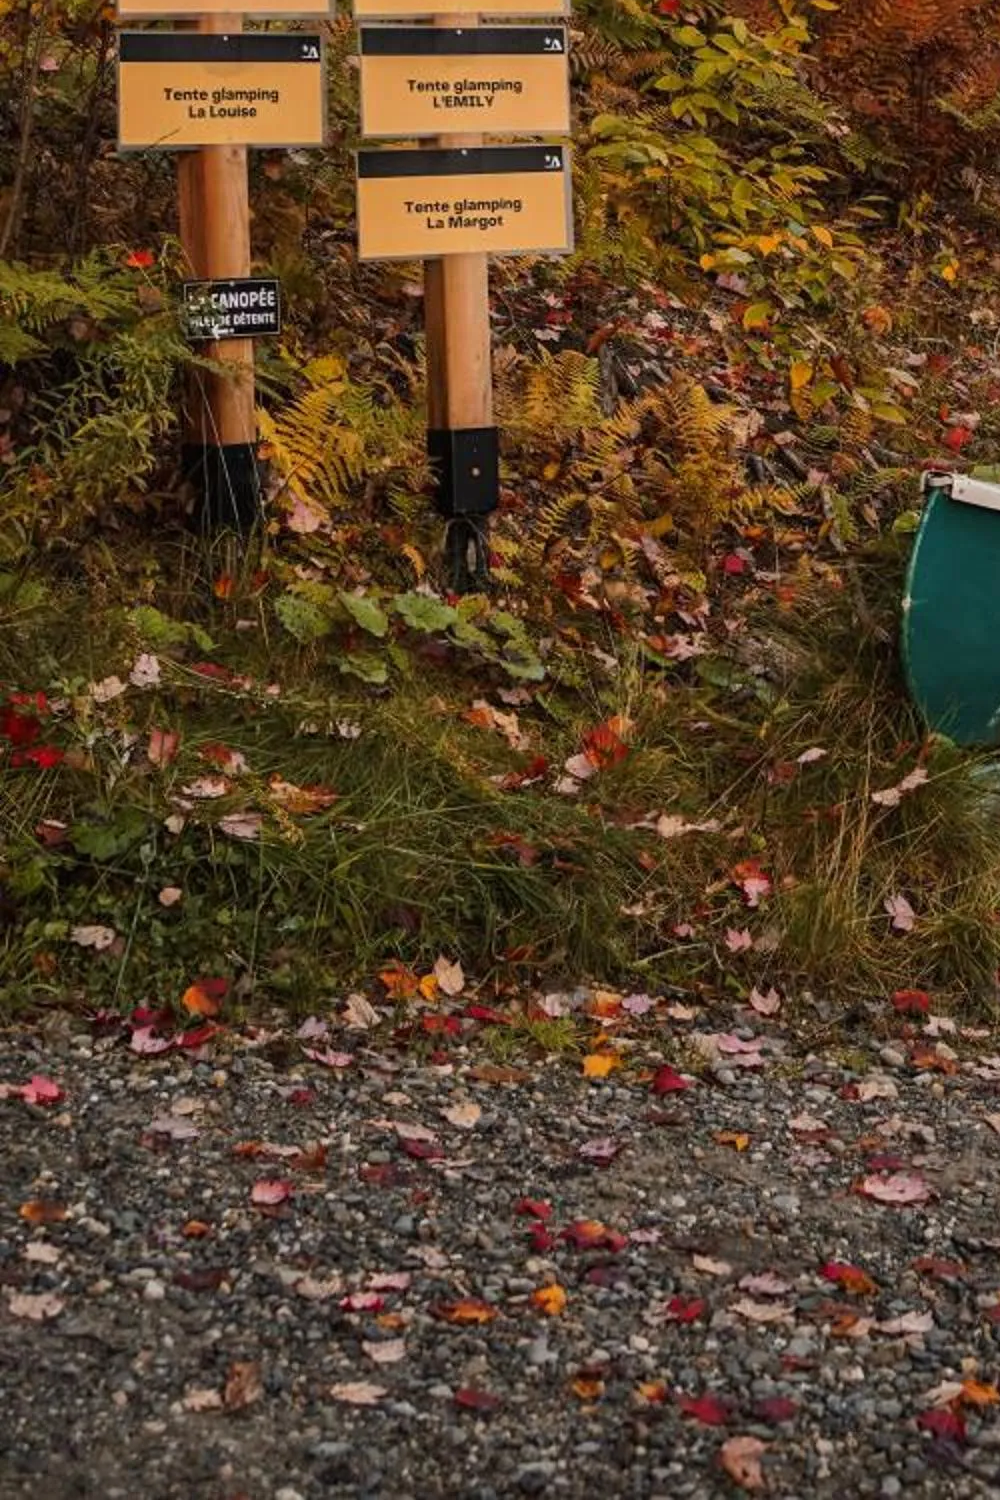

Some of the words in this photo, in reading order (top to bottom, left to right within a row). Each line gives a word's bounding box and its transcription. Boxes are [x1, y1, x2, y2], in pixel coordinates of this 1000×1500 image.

[407, 79, 450, 92] Tente
[453, 79, 523, 94] glamping
[163, 88, 208, 101] Tente
[211, 88, 279, 104] glamping
[433, 95, 495, 109] L'EMILY
[188, 105, 205, 119] La
[209, 105, 257, 118] Louise
[404, 201, 449, 213] Tente
[454, 197, 522, 214] glamping
[426, 216, 445, 229] La
[448, 215, 504, 231] Margot
[233, 311, 276, 325] DÉTENTE
